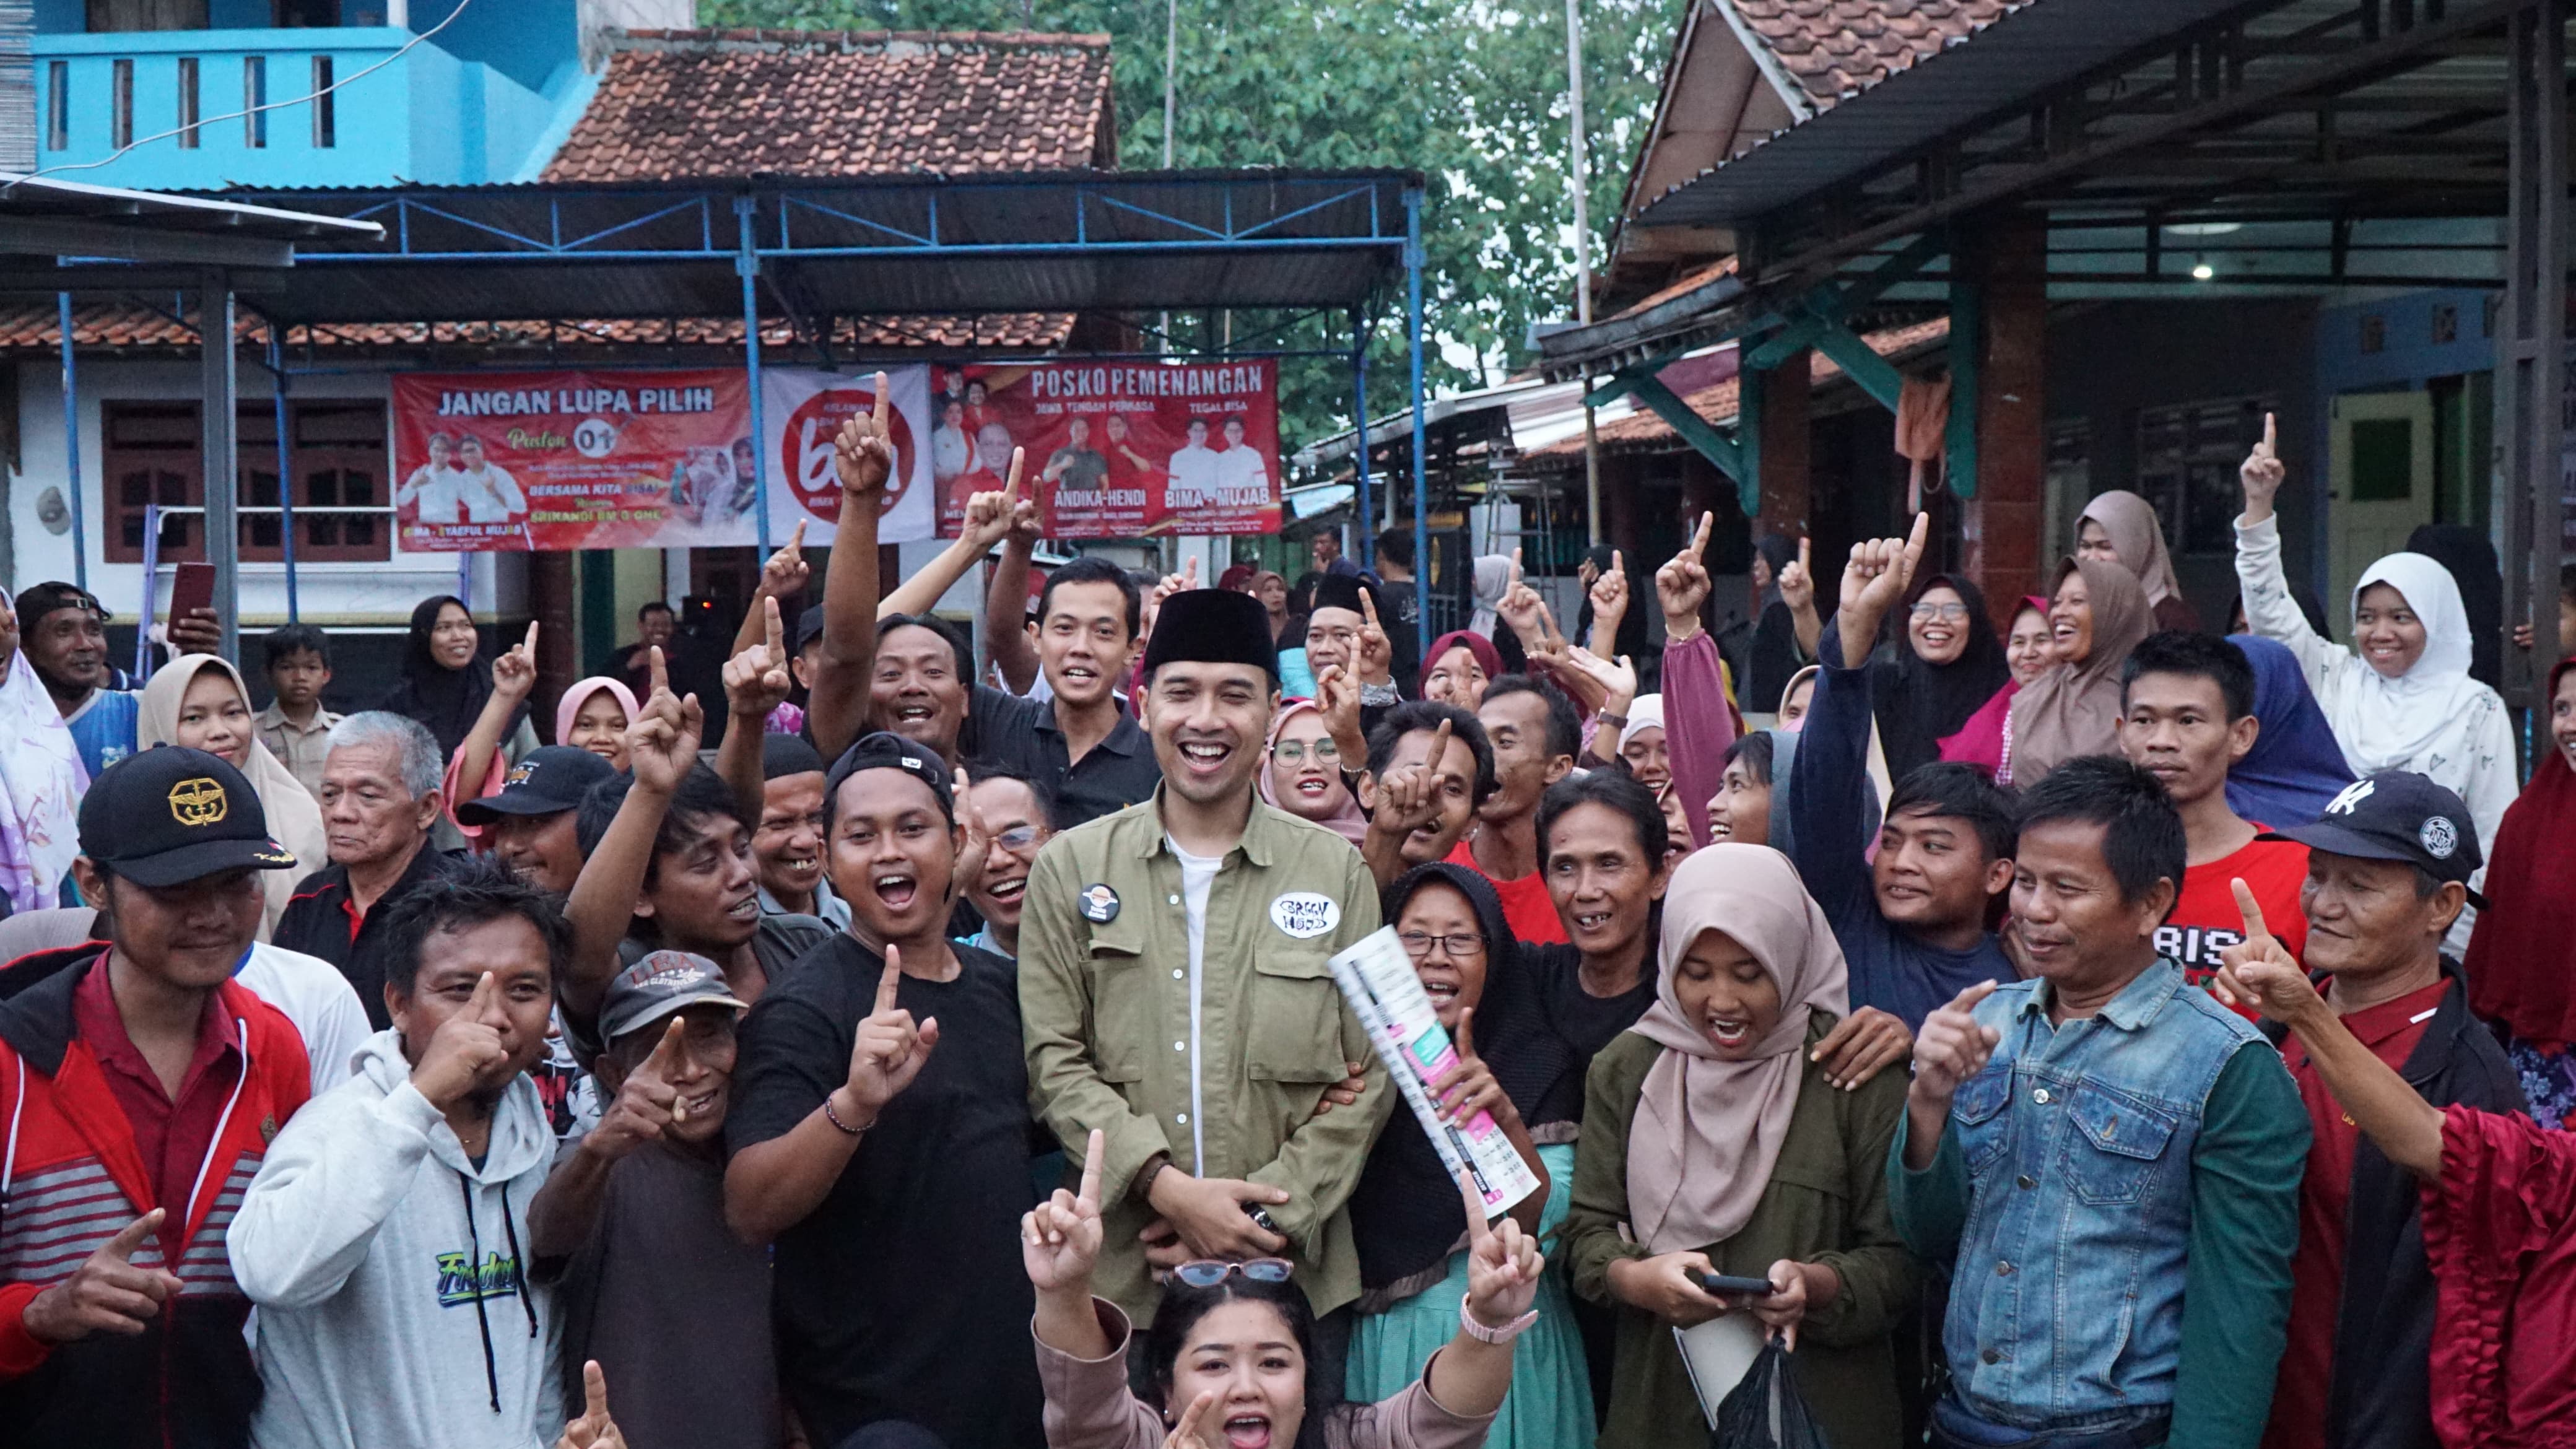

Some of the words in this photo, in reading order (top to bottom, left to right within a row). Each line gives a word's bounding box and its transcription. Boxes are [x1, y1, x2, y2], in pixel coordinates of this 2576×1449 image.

[1032, 368, 1107, 398] POSKO
[1112, 366, 1263, 396] PEMENANGAN
[438, 390, 551, 416] JANGAN
[559, 389, 632, 414] LUPA
[638, 388, 713, 412] PILIH
[1067, 401, 1107, 413] TENGAH
[1190, 401, 1222, 414] TEGAL
[1224, 401, 1248, 412] BISA
[577, 429, 613, 451] 01
[529, 484, 590, 496] BERSAMA
[593, 484, 622, 495] KITA
[1055, 489, 1146, 507] ANDIKA-HENDI
[1165, 489, 1204, 508] BIMA
[1216, 487, 1269, 507] MUJAB
[530, 510, 593, 523] SRIKANDI
[403, 526, 430, 537] BIMA
[485, 524, 521, 536] MUJAB
[631, 954, 696, 984] LEA
